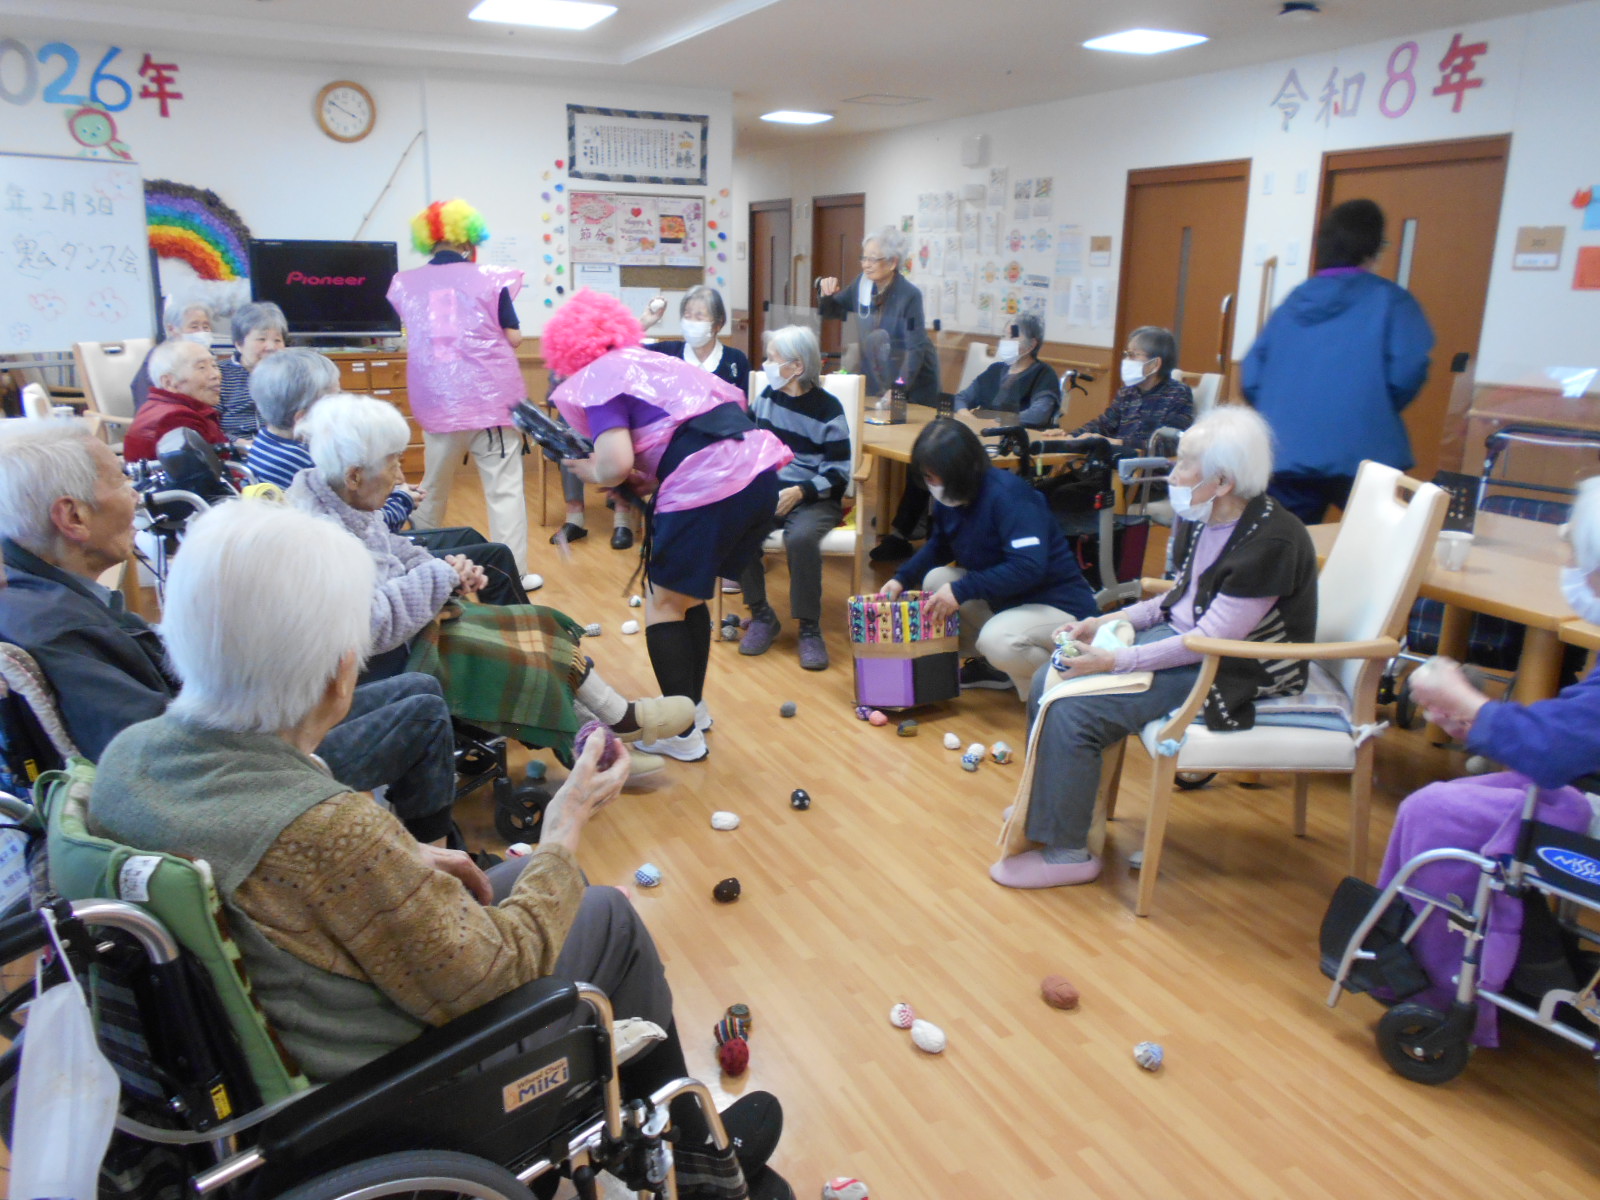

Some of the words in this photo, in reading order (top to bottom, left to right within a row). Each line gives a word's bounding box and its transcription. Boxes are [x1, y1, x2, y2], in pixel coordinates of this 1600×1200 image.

[1270, 33, 1488, 131] 令和8年
[580, 227, 607, 241] 節分
[285, 270, 367, 286] Pioneer
